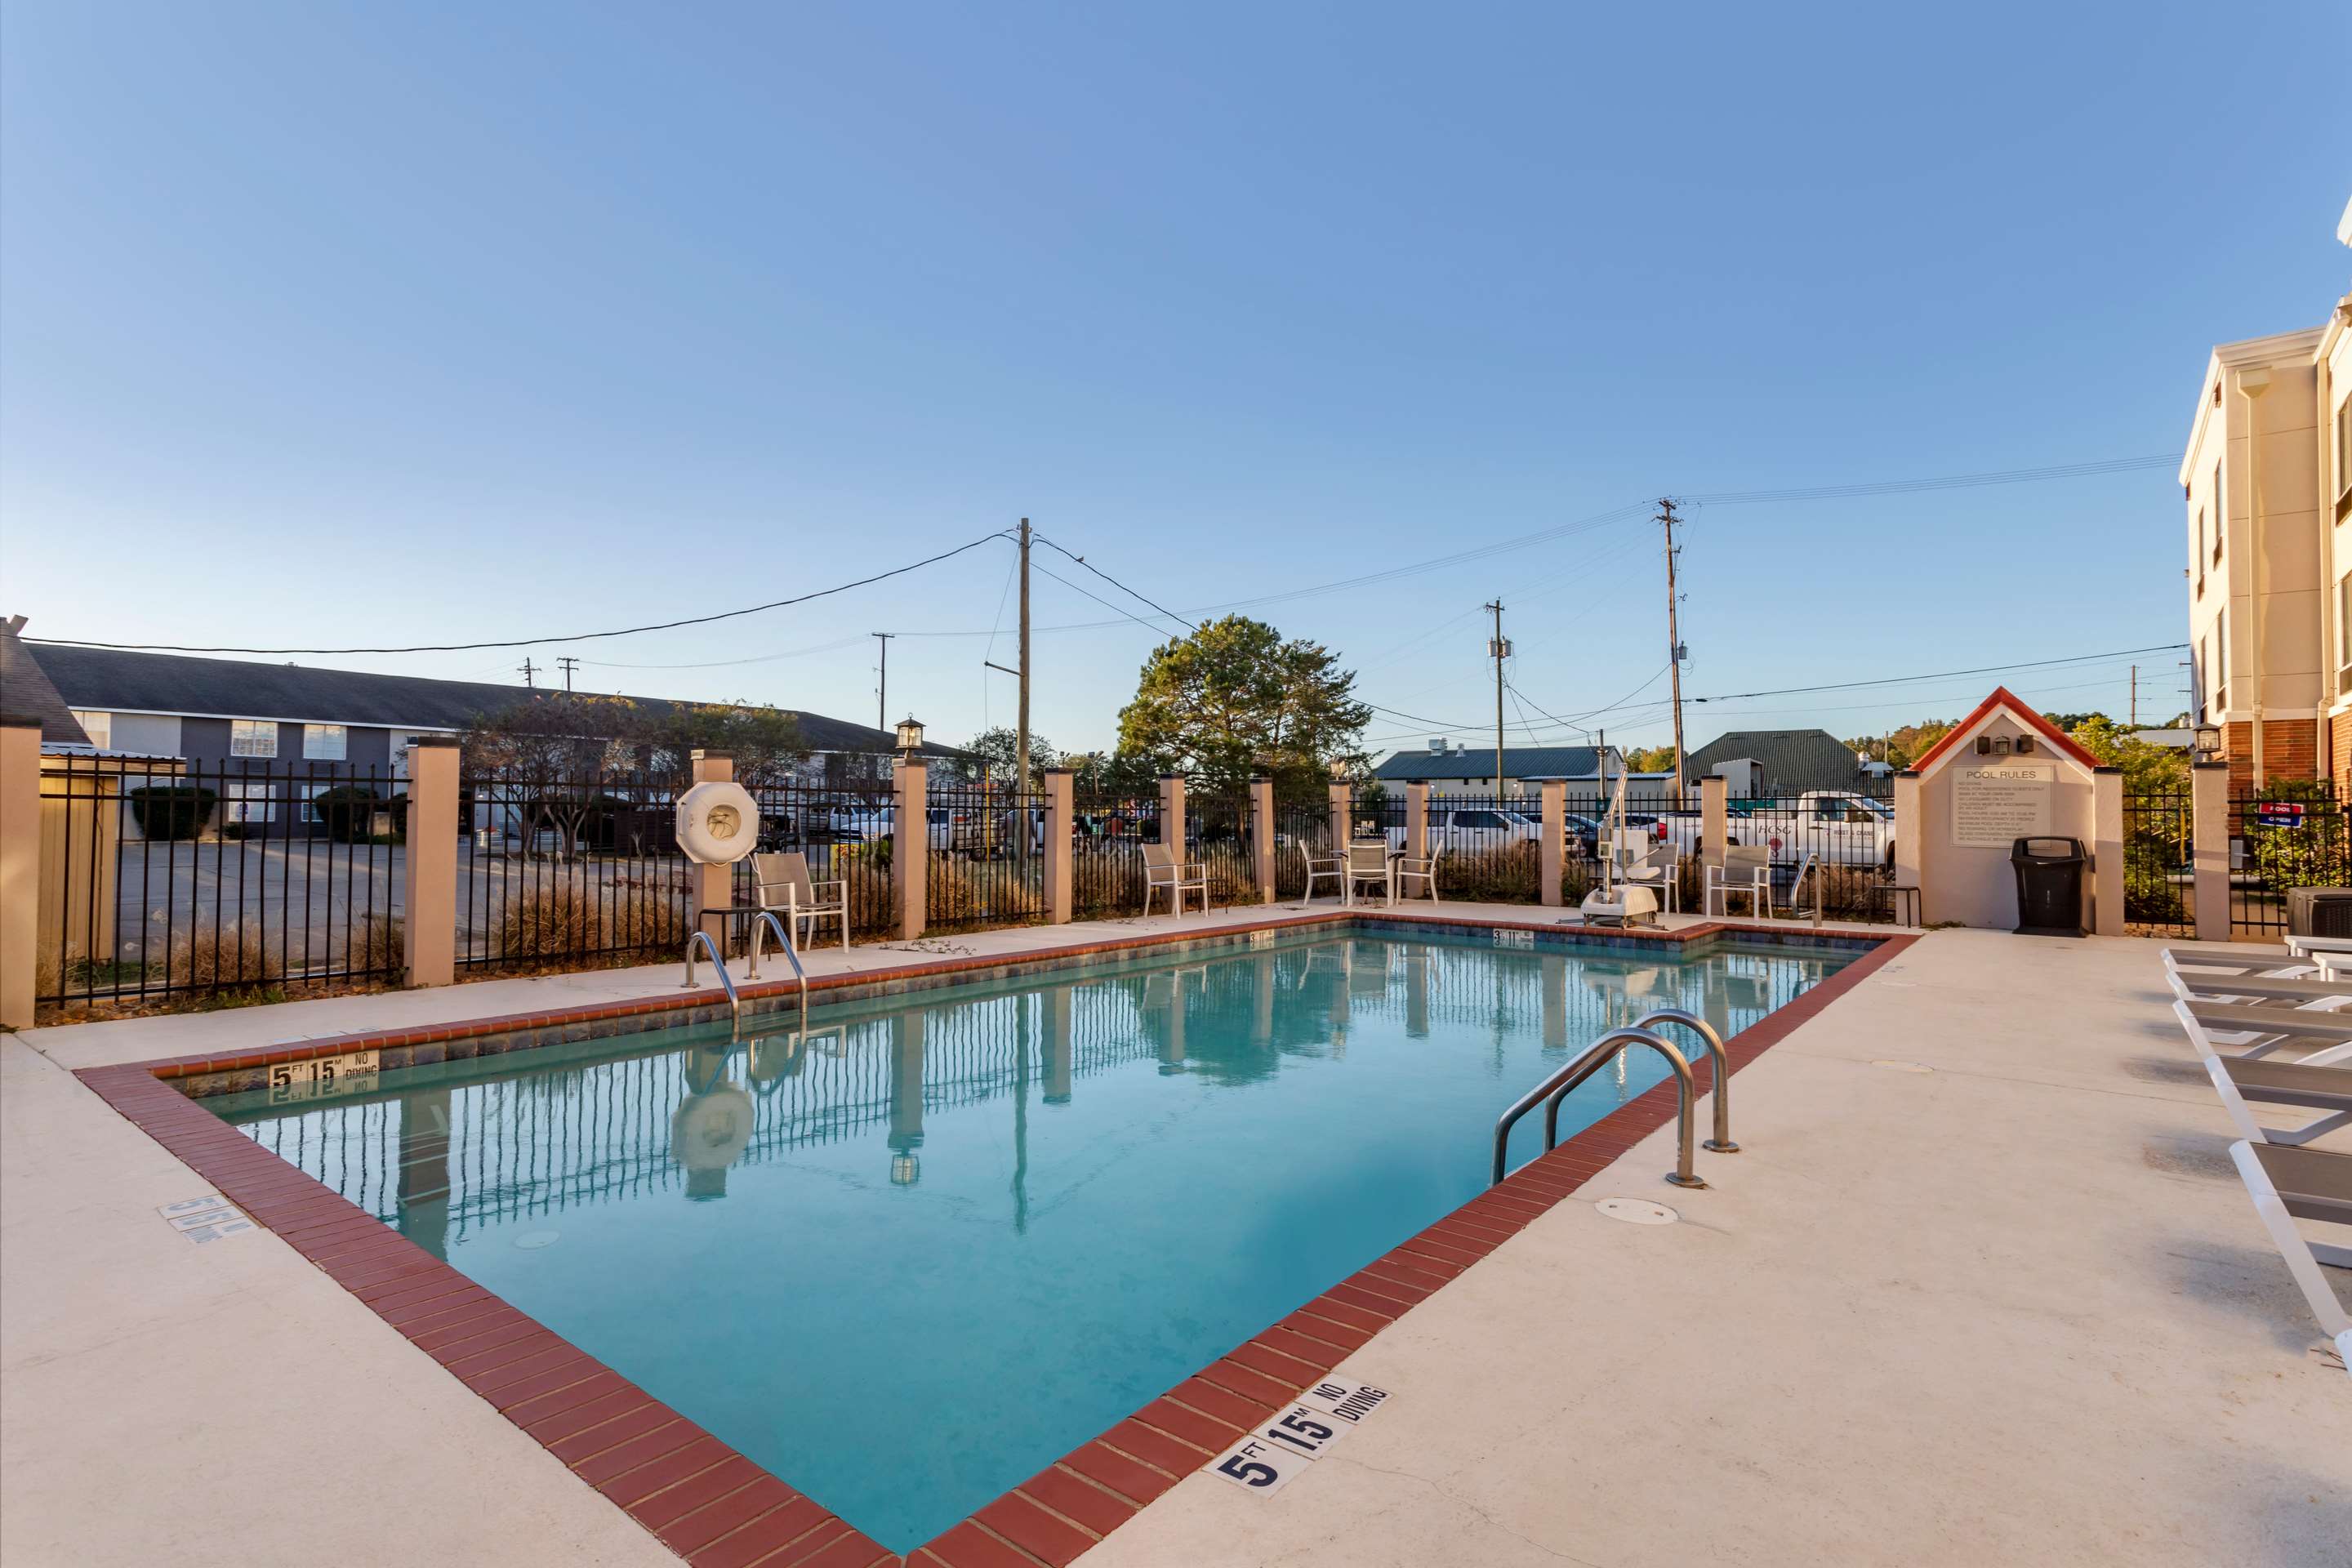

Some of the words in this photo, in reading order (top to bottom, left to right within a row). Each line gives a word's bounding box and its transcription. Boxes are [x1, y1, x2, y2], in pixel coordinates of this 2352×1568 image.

[1758, 825, 1792, 835] HCSG
[355, 1053, 368, 1065] NO
[274, 1066, 291, 1086] 5
[292, 1064, 304, 1073] FT
[1312, 1383, 1348, 1401] NO
[1294, 1407, 1311, 1418] M
[1332, 1386, 1388, 1422] DIVING
[1267, 1414, 1334, 1451] 1.5
[1241, 1441, 1267, 1459] FT
[1217, 1454, 1278, 1487] 5
